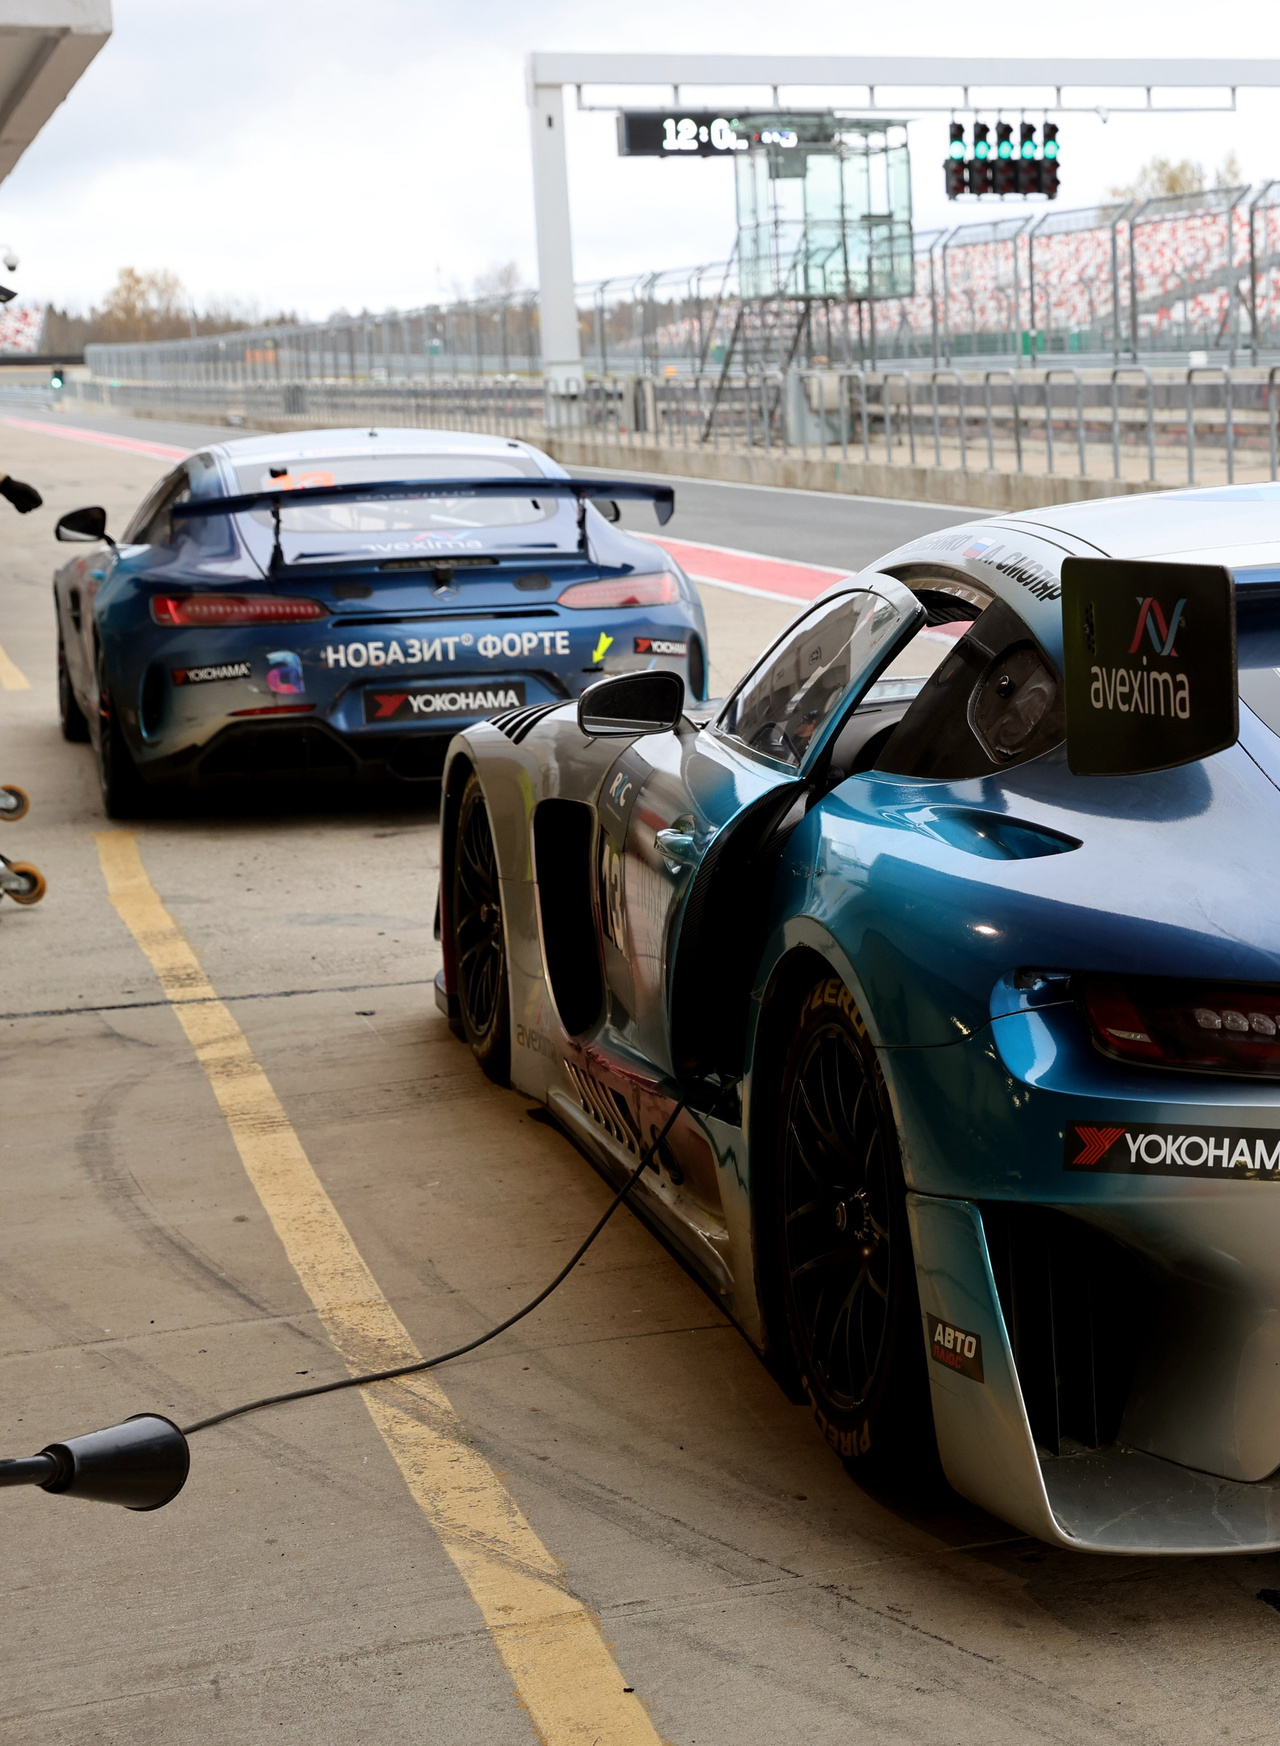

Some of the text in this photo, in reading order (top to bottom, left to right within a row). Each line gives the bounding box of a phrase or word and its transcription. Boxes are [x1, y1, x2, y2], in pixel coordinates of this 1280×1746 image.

[477, 631, 570, 659] ФОРТЕ
[186, 662, 251, 683] YOKOHAMA
[1090, 655, 1190, 719] avexima
[407, 690, 520, 713] YOKOHAMA
[934, 1323, 977, 1359] АВТО
